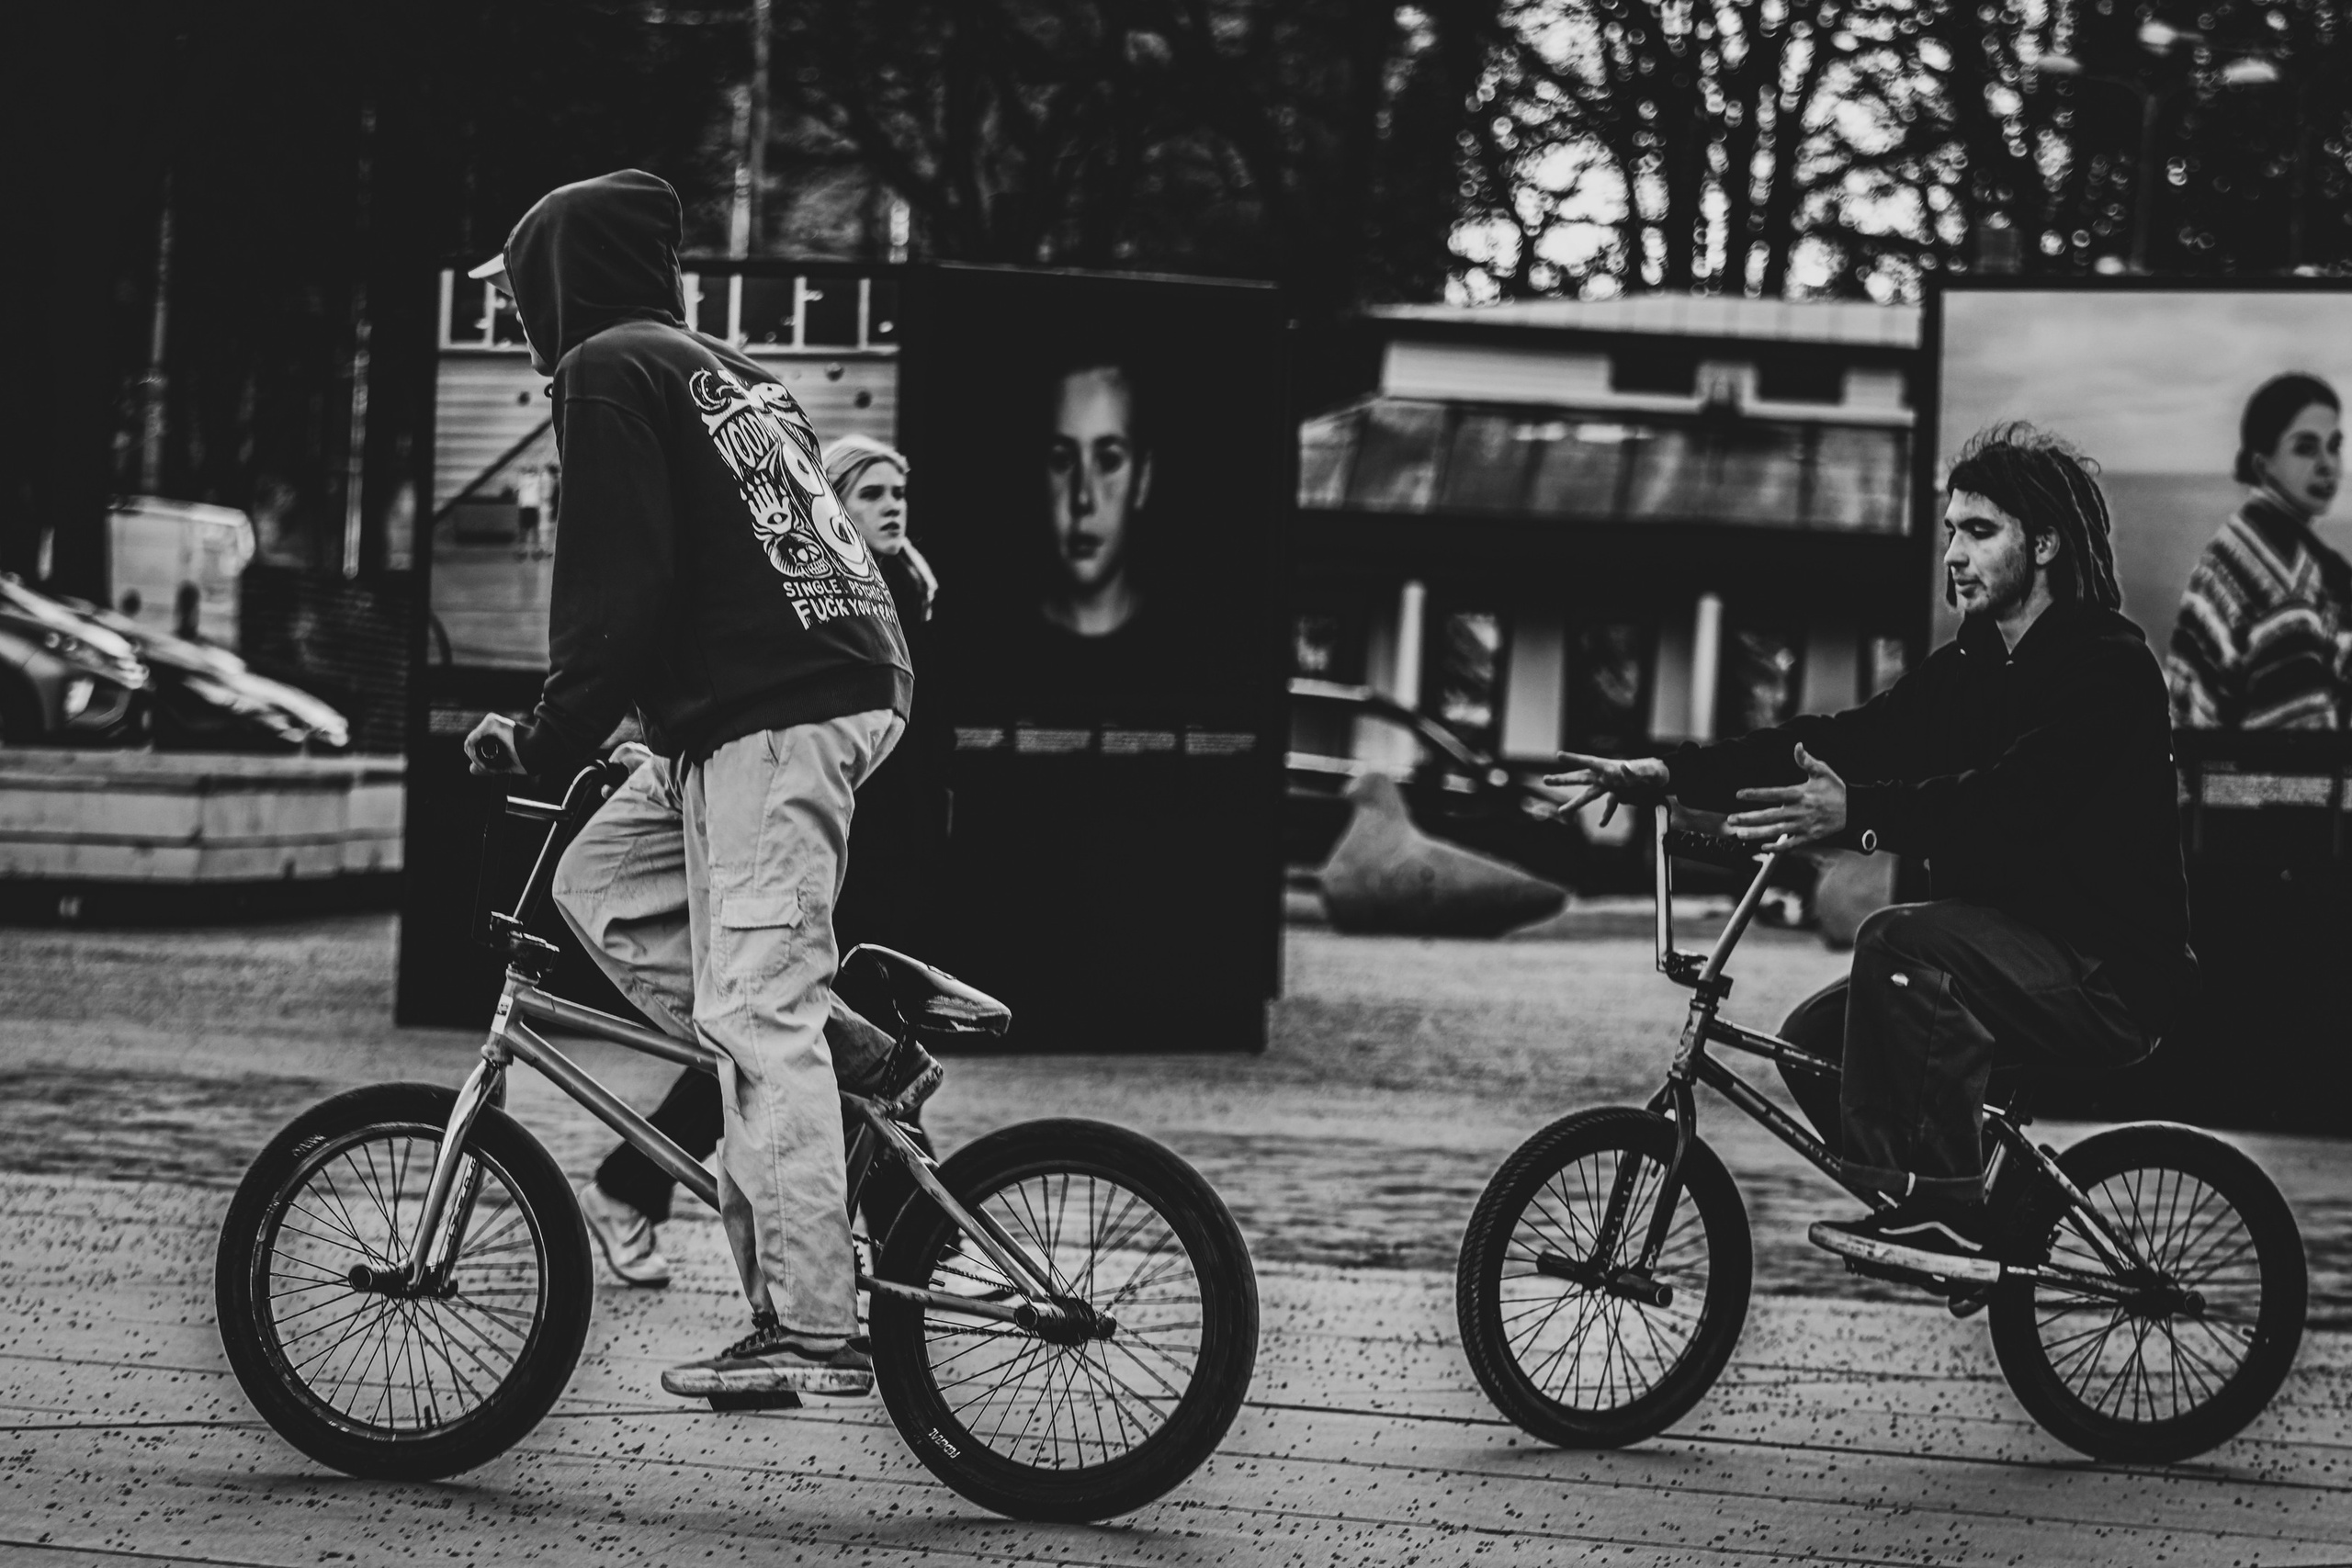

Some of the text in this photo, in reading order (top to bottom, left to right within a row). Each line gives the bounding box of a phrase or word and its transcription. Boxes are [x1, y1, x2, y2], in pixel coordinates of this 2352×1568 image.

[783, 579, 842, 597] SINGLE
[791, 597, 851, 631] FUCK
[928, 1427, 961, 1459] FEDERAL
